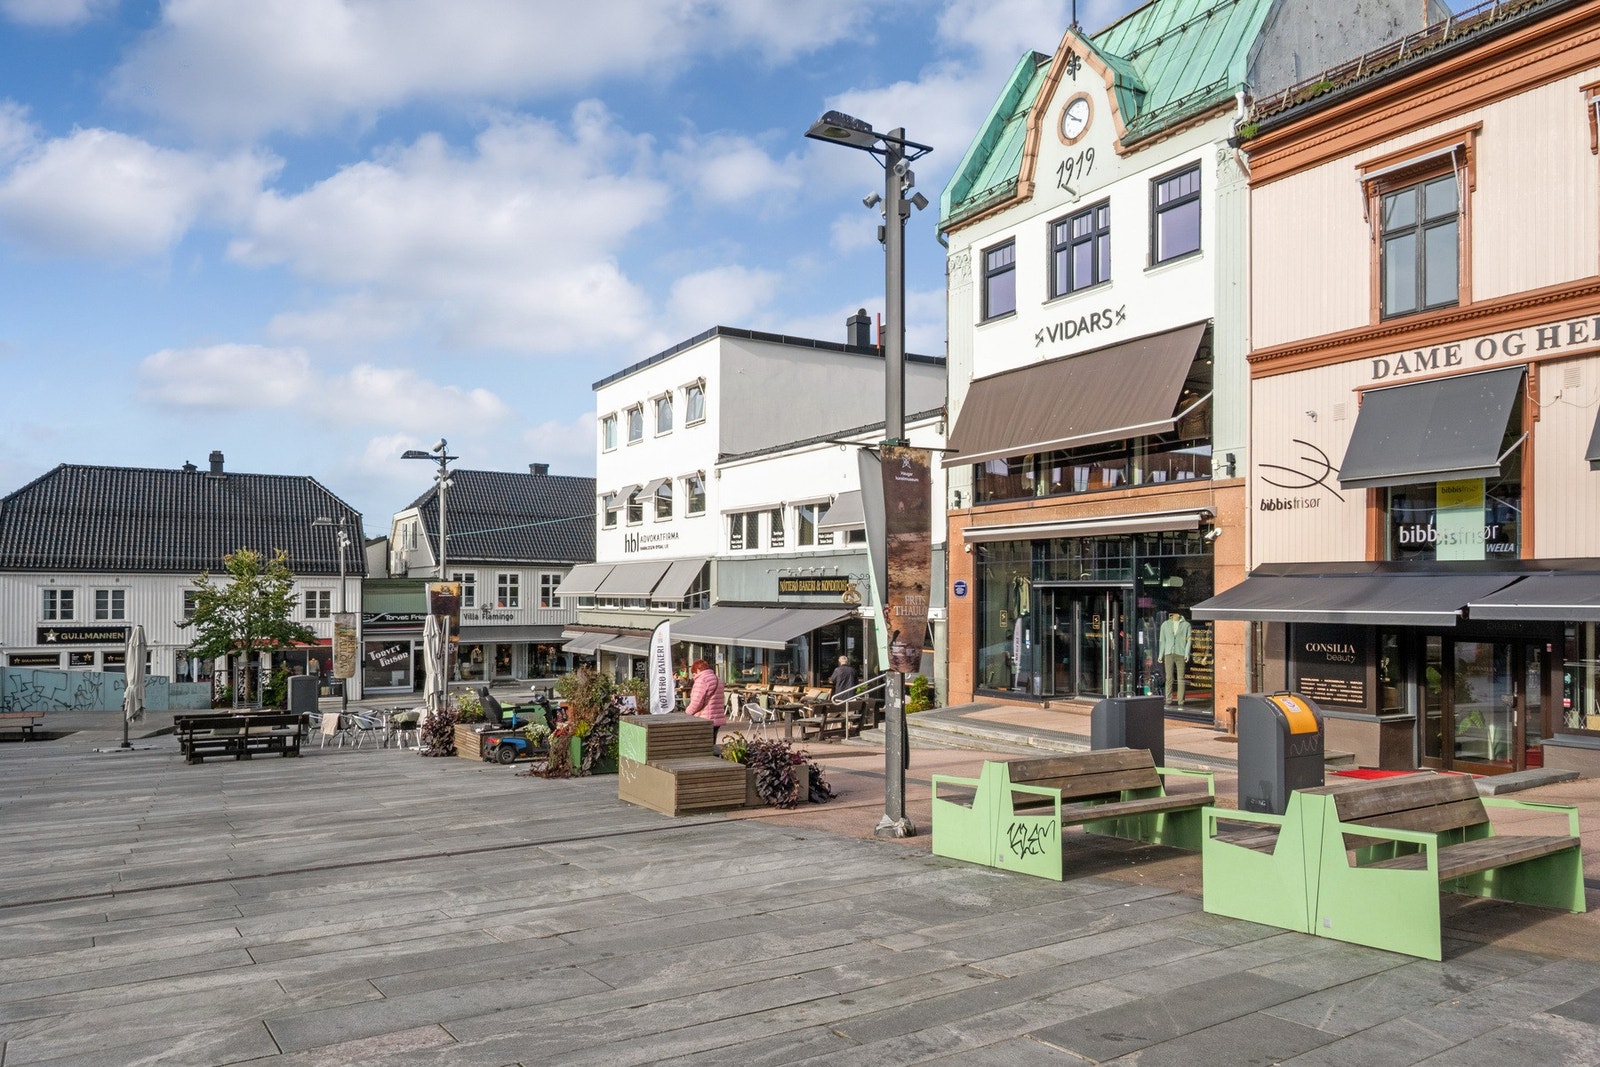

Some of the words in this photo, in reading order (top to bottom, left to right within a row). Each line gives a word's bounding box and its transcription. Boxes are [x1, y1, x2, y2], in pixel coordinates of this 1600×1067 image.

[1056, 147, 1095, 190] 1919
[1046, 308, 1113, 343] VIDARS
[1372, 343, 1463, 380] DAME
[1474, 332, 1526, 361] OG
[625, 533, 639, 553] hbl
[640, 532, 679, 543] ADVOKATFIRMA
[1486, 543, 1515, 553] WELLA
[905, 595, 927, 605] FRITS
[894, 606, 928, 615] THAULO
[482, 613, 513, 621] Flamingo
[61, 632, 125, 640] GULLMANNEN
[1306, 643, 1355, 653] CONSILIA
[1327, 653, 1355, 663] beauty
